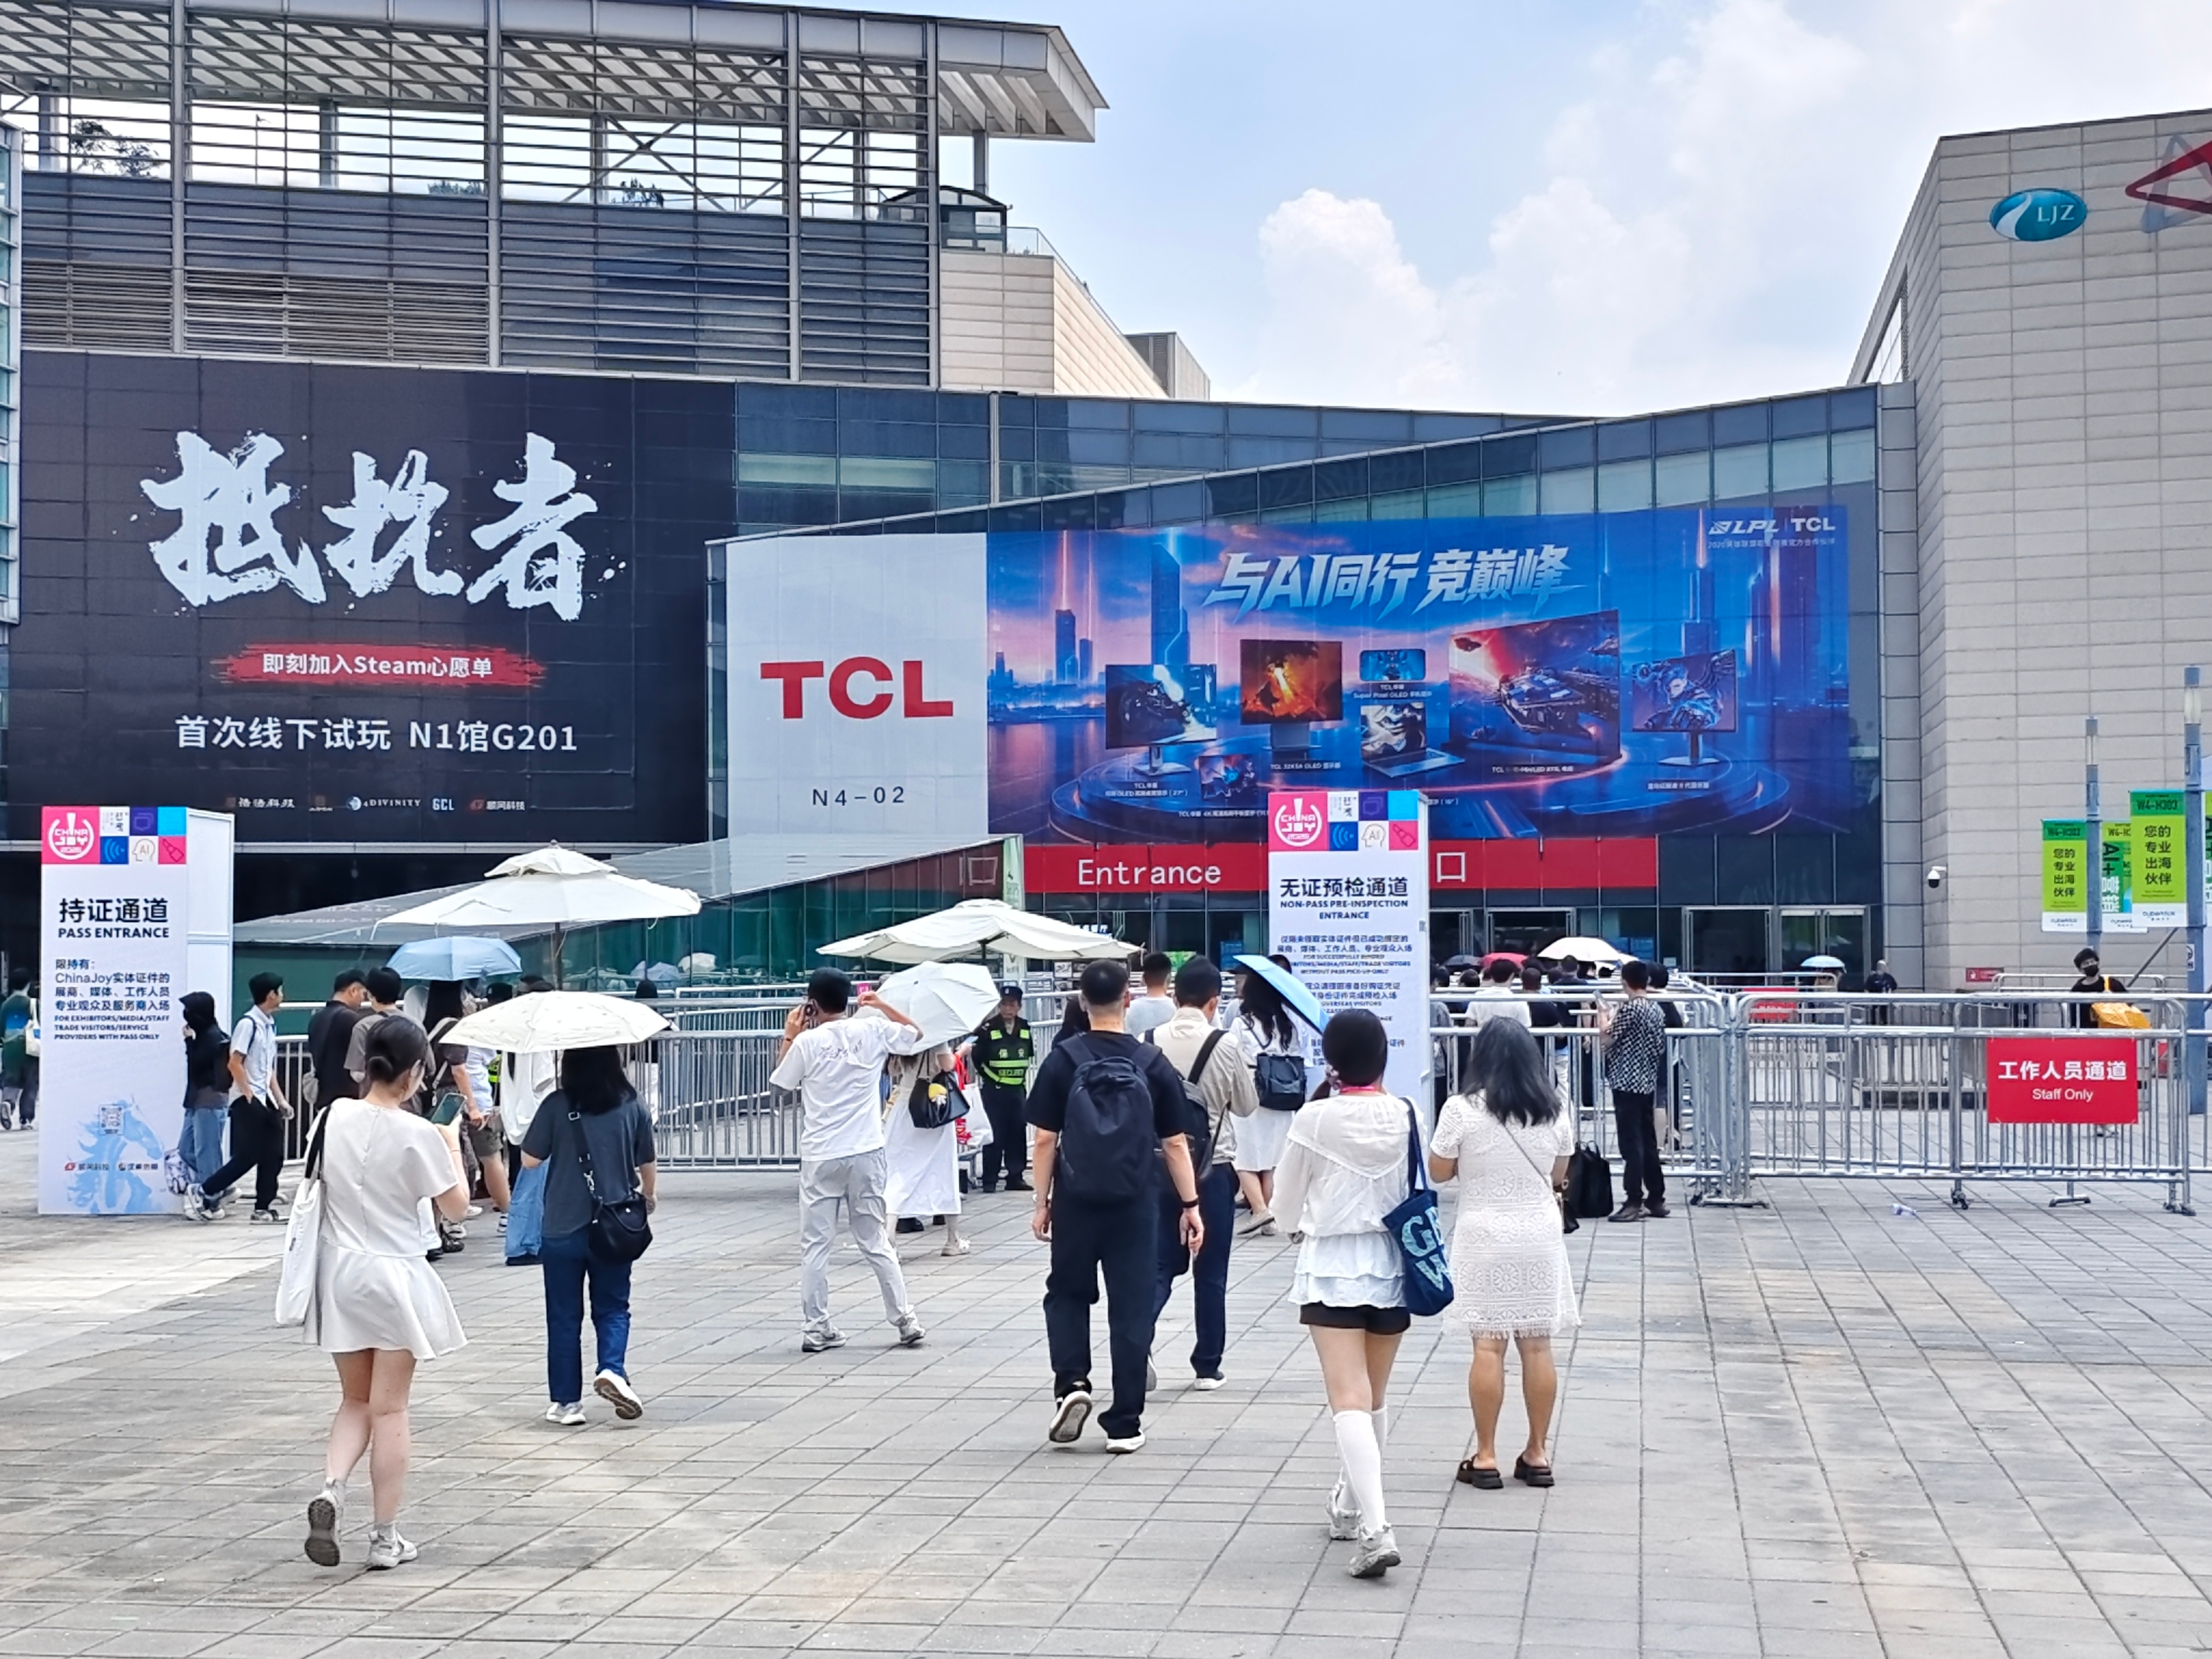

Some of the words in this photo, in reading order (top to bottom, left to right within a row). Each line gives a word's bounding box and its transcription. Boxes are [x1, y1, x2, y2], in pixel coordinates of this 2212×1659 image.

[2037, 205, 2075, 225] LJZ
[1731, 520, 1780, 534] LPL
[1790, 517, 1836, 532] TCL
[1201, 551, 1422, 616] 与AI同行
[1412, 544, 1586, 616] 竞巅峰
[262, 652, 493, 678] 即刻加入Steam心愿单
[760, 656, 954, 719] TCL
[176, 715, 391, 752] 首次线下试玩
[410, 719, 578, 753] N1馆G201
[812, 786, 905, 806] N4-02
[363, 799, 421, 807] 4DIVINITY
[432, 798, 454, 810] GCL
[1282, 822, 1316, 832] JOY
[2144, 825, 2170, 838] 您的
[55, 837, 88, 846] JOY
[1369, 831, 1379, 840] AI
[140, 845, 150, 854] AI
[2053, 848, 2075, 859] 您的
[2144, 841, 2171, 854] 专业
[2054, 861, 2075, 871] 专业
[2145, 857, 2171, 869] 出海
[1078, 859, 1222, 885] Entrance
[2144, 872, 2172, 885] 伙伴
[2054, 874, 2074, 885] 出海
[1279, 876, 1408, 898] 无证预检通道
[2054, 887, 2075, 897] 伙伴
[59, 898, 169, 923] 持证通道
[58, 928, 91, 938] PASS
[95, 928, 169, 938] ENTRANCE
[55, 972, 170, 985] ChinaJoy实体证件的
[55, 1000, 170, 1011] 专业观众及服务商入场
[1998, 1061, 2127, 1081] 工作人员通道
[2032, 1088, 2061, 1101] Staff
[2065, 1088, 2093, 1103] Only
